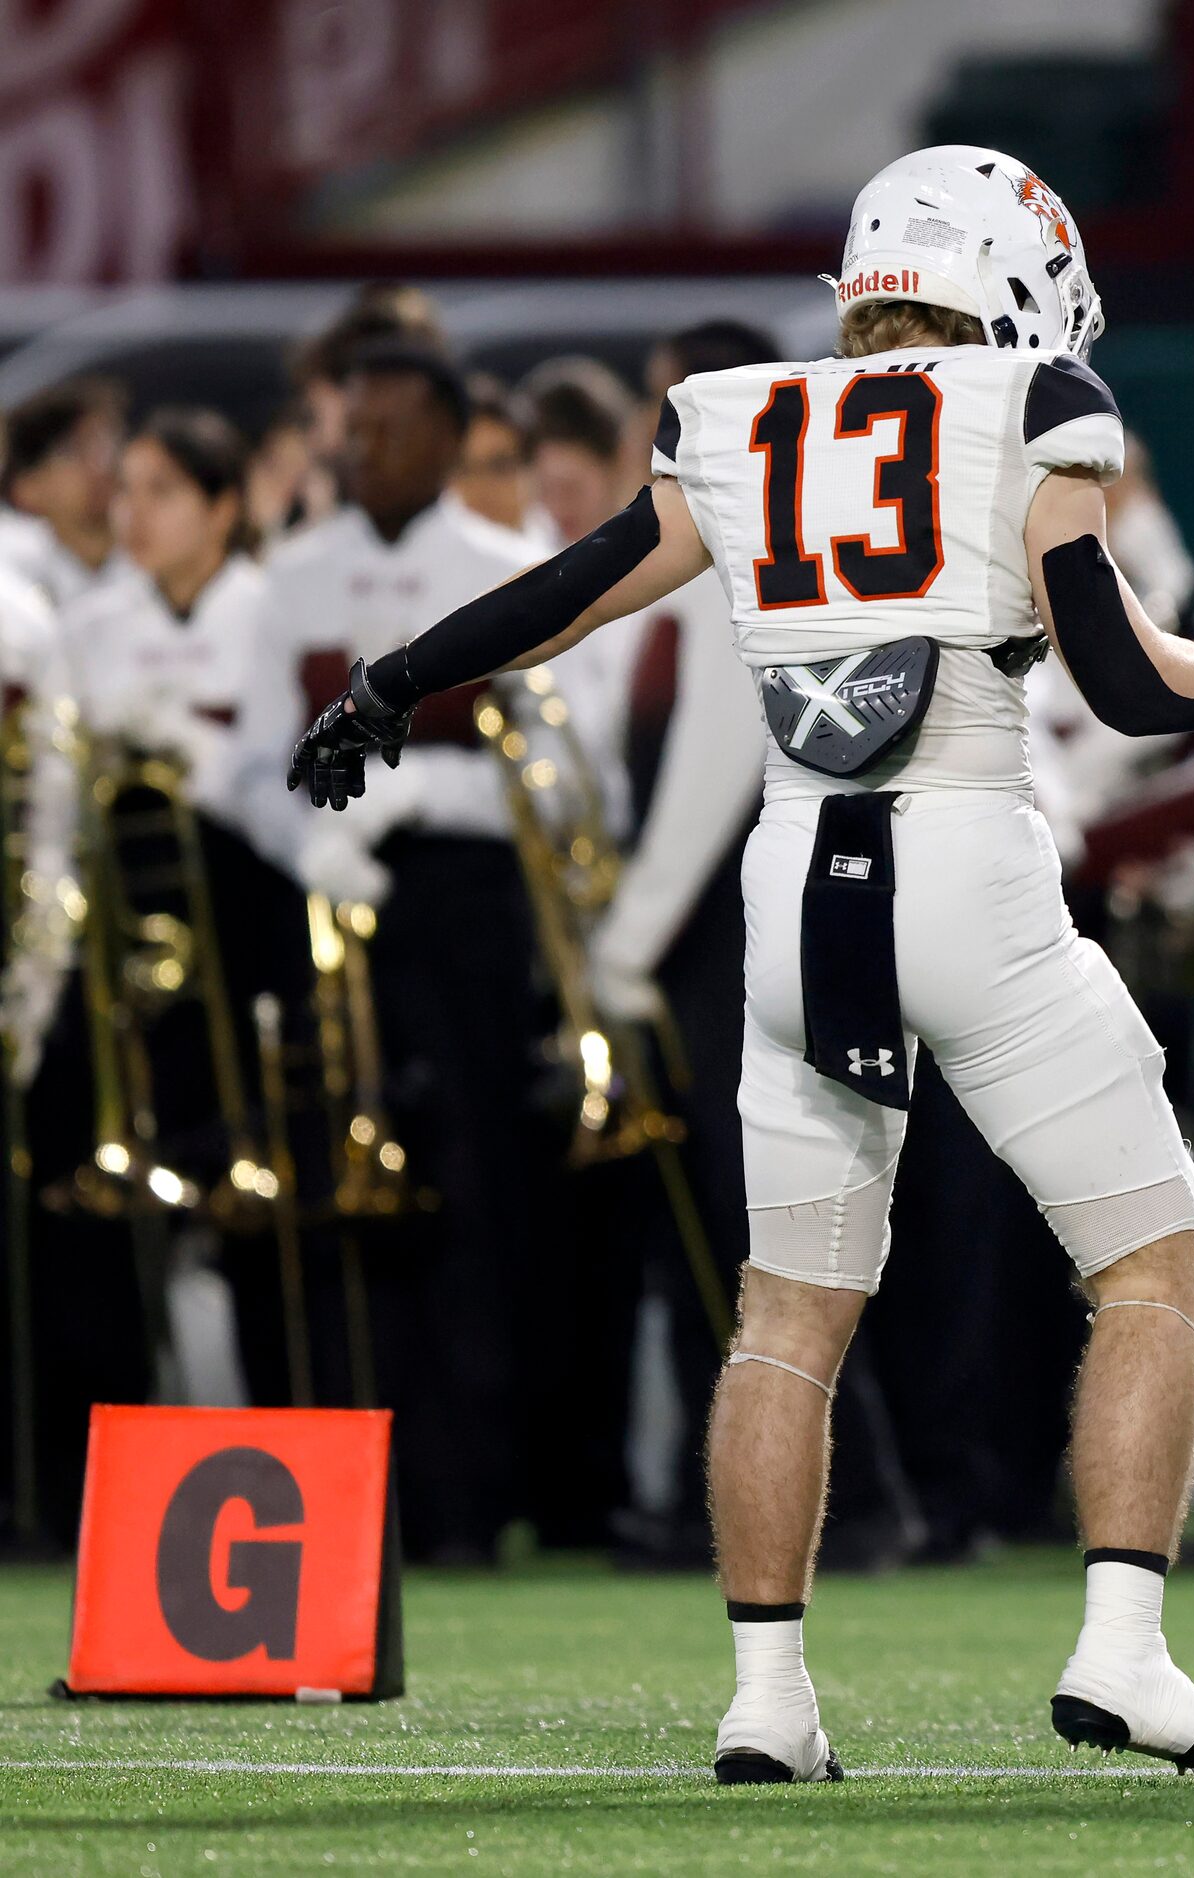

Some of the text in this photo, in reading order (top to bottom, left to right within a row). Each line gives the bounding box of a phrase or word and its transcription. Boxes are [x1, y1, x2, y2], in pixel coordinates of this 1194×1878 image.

[838, 270, 919, 302] Riddell
[748, 371, 945, 611] 13
[155, 1445, 306, 1663] G
